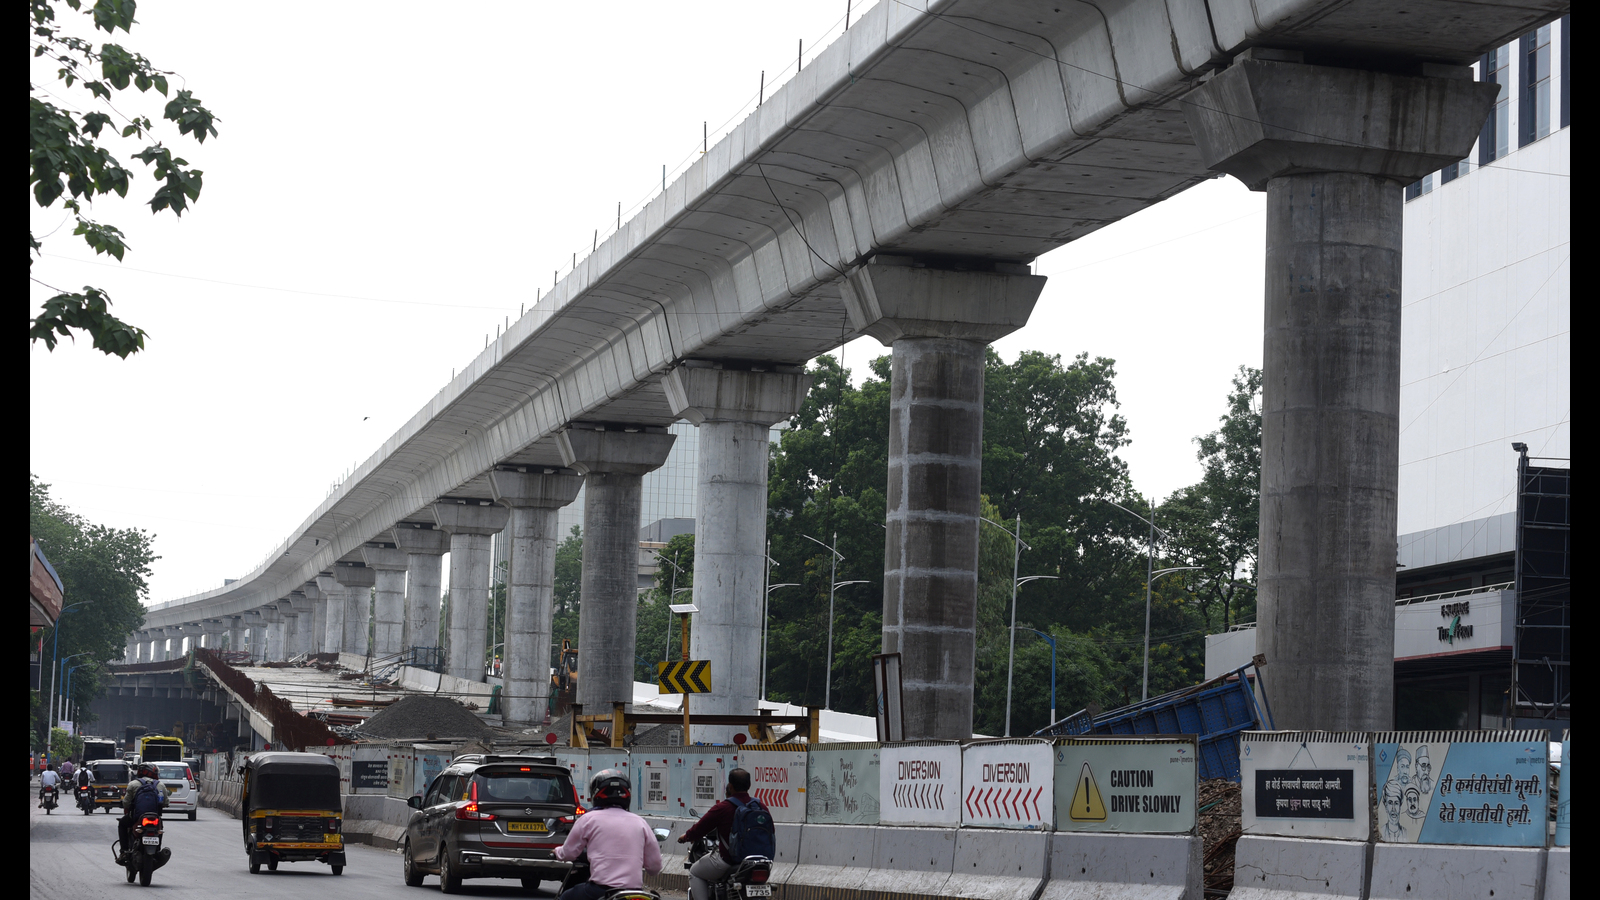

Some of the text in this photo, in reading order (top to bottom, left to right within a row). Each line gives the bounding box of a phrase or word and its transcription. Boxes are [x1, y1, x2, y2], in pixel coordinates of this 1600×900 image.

[754, 766, 788, 783] DIVERSION
[898, 760, 941, 780] DIVERSION
[983, 762, 1030, 783] DIVERSION
[1110, 769, 1154, 788] CAUTION
[1440, 773, 1543, 800] ही कर्मवीरांची भूमी,
[1111, 795, 1181, 813] DRIVE SLOWLY
[1439, 802, 1532, 827] देते प्रगतीची हमी.
[511, 823, 547, 831] MH14KA378
